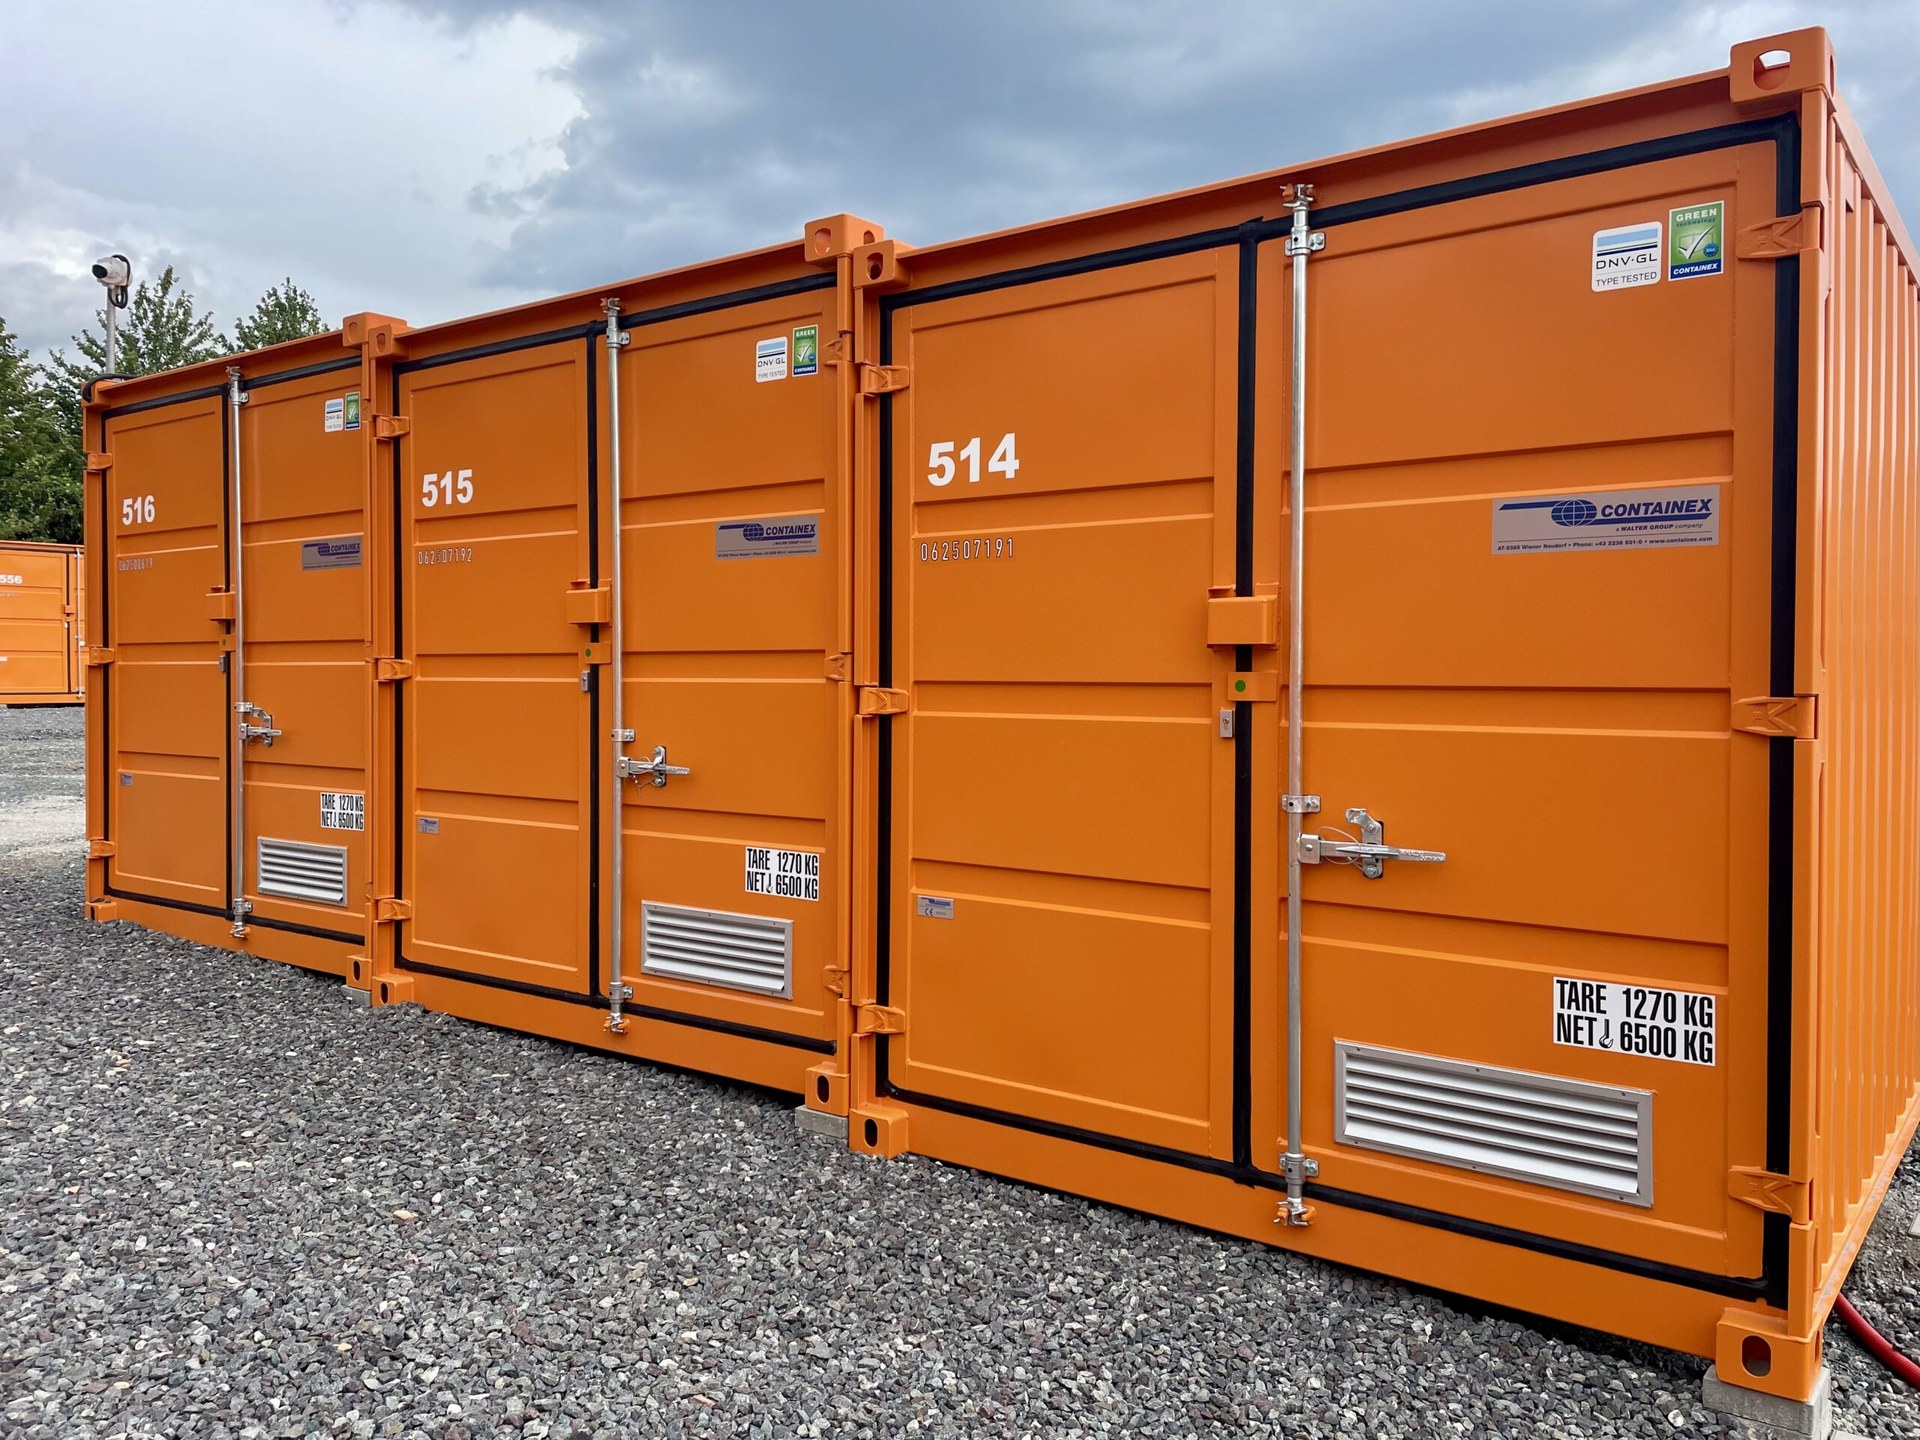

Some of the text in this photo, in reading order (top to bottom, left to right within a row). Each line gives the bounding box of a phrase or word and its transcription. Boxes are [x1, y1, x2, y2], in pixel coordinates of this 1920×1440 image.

[1676, 208, 1717, 222] GREEN
[1673, 263, 1718, 275] CONTAINEX
[1596, 271, 1657, 287] TYPE TESTED
[795, 329, 815, 337] GREEN
[927, 432, 1020, 487] 514
[421, 469, 473, 507] 515
[122, 494, 155, 526] 516
[1600, 498, 1712, 518] CONTAINEX
[765, 524, 816, 536] CONTAINEX
[1674, 522, 1704, 530] company
[417, 548, 472, 565] 062507192
[920, 537, 1014, 562] 062507191
[321, 793, 363, 812] TARE 1270 KG
[321, 811, 363, 830] NET 6500 KG
[747, 848, 818, 876] TARE 1270 KG
[747, 870, 818, 900] NET 6500 KG
[1556, 979, 1713, 1028] TARE 1270 KG
[1556, 1012, 1713, 1064] NET 6500 KG
